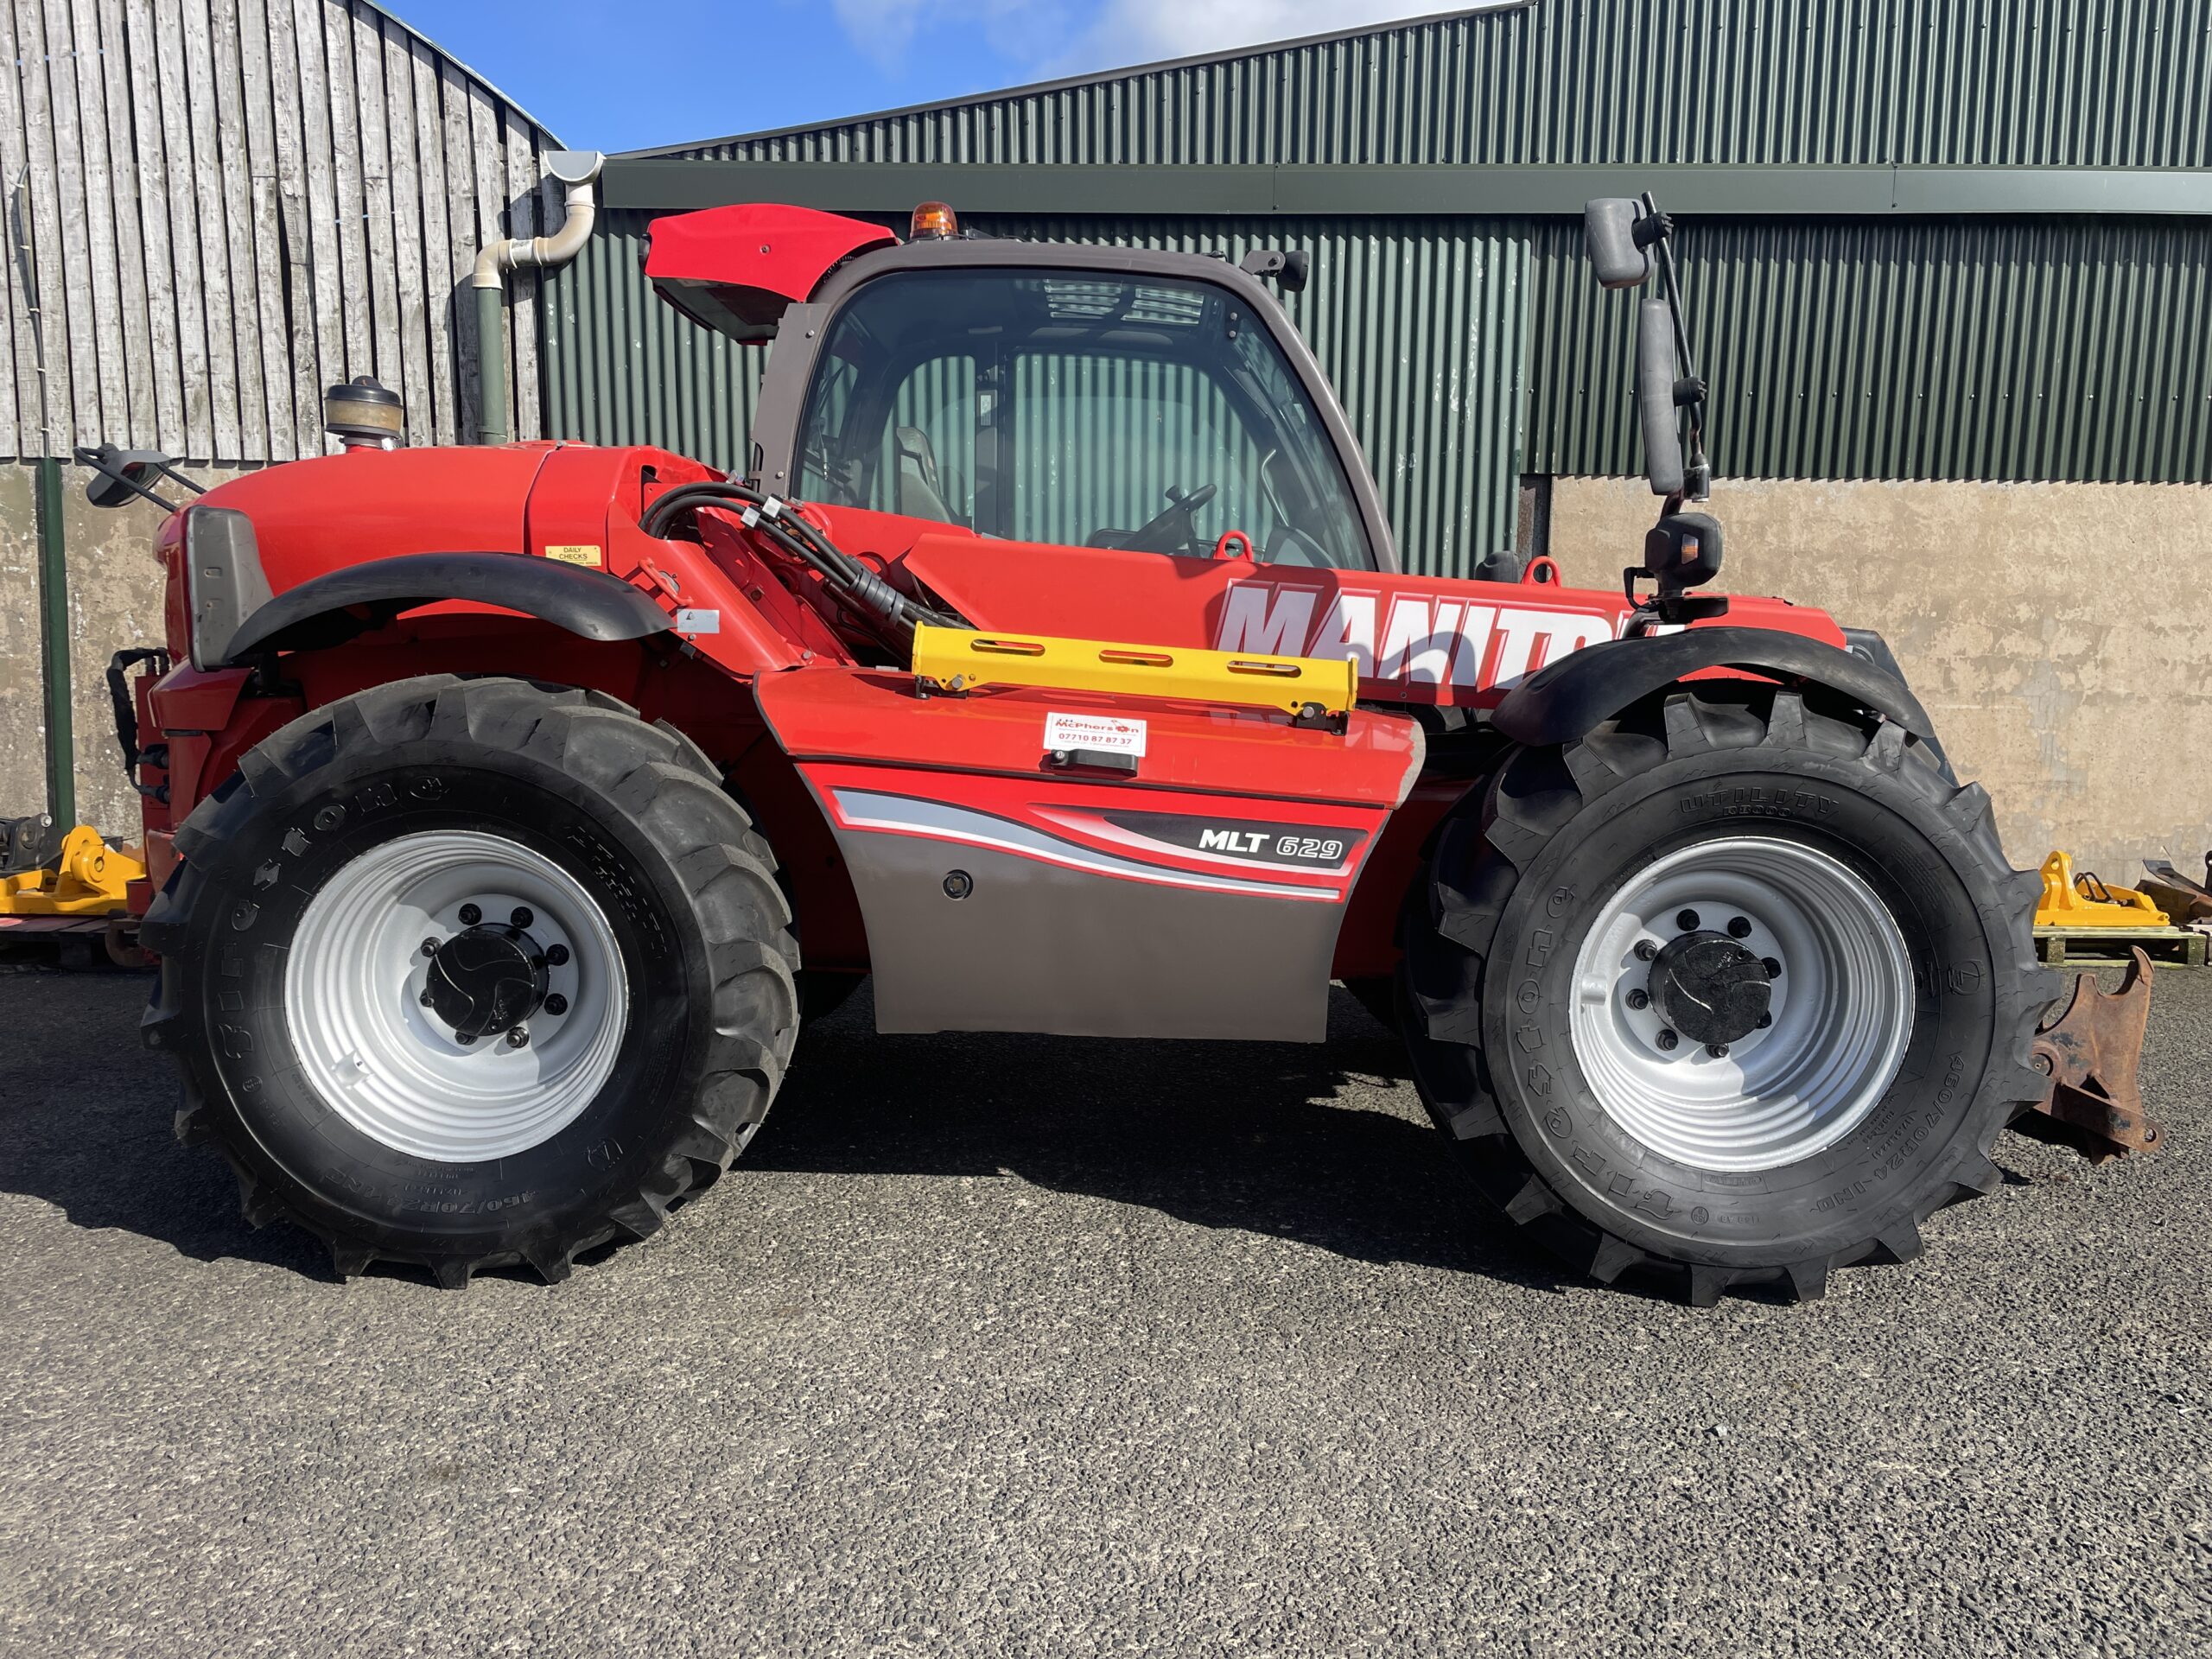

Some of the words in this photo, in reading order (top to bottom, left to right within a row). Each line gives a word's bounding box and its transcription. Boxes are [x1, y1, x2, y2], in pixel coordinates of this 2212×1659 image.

[1058, 733, 1089, 741] 07710
[1680, 786, 1840, 814] UTILITY
[1198, 829, 1270, 853] MLT
[1275, 836, 1344, 860] 629
